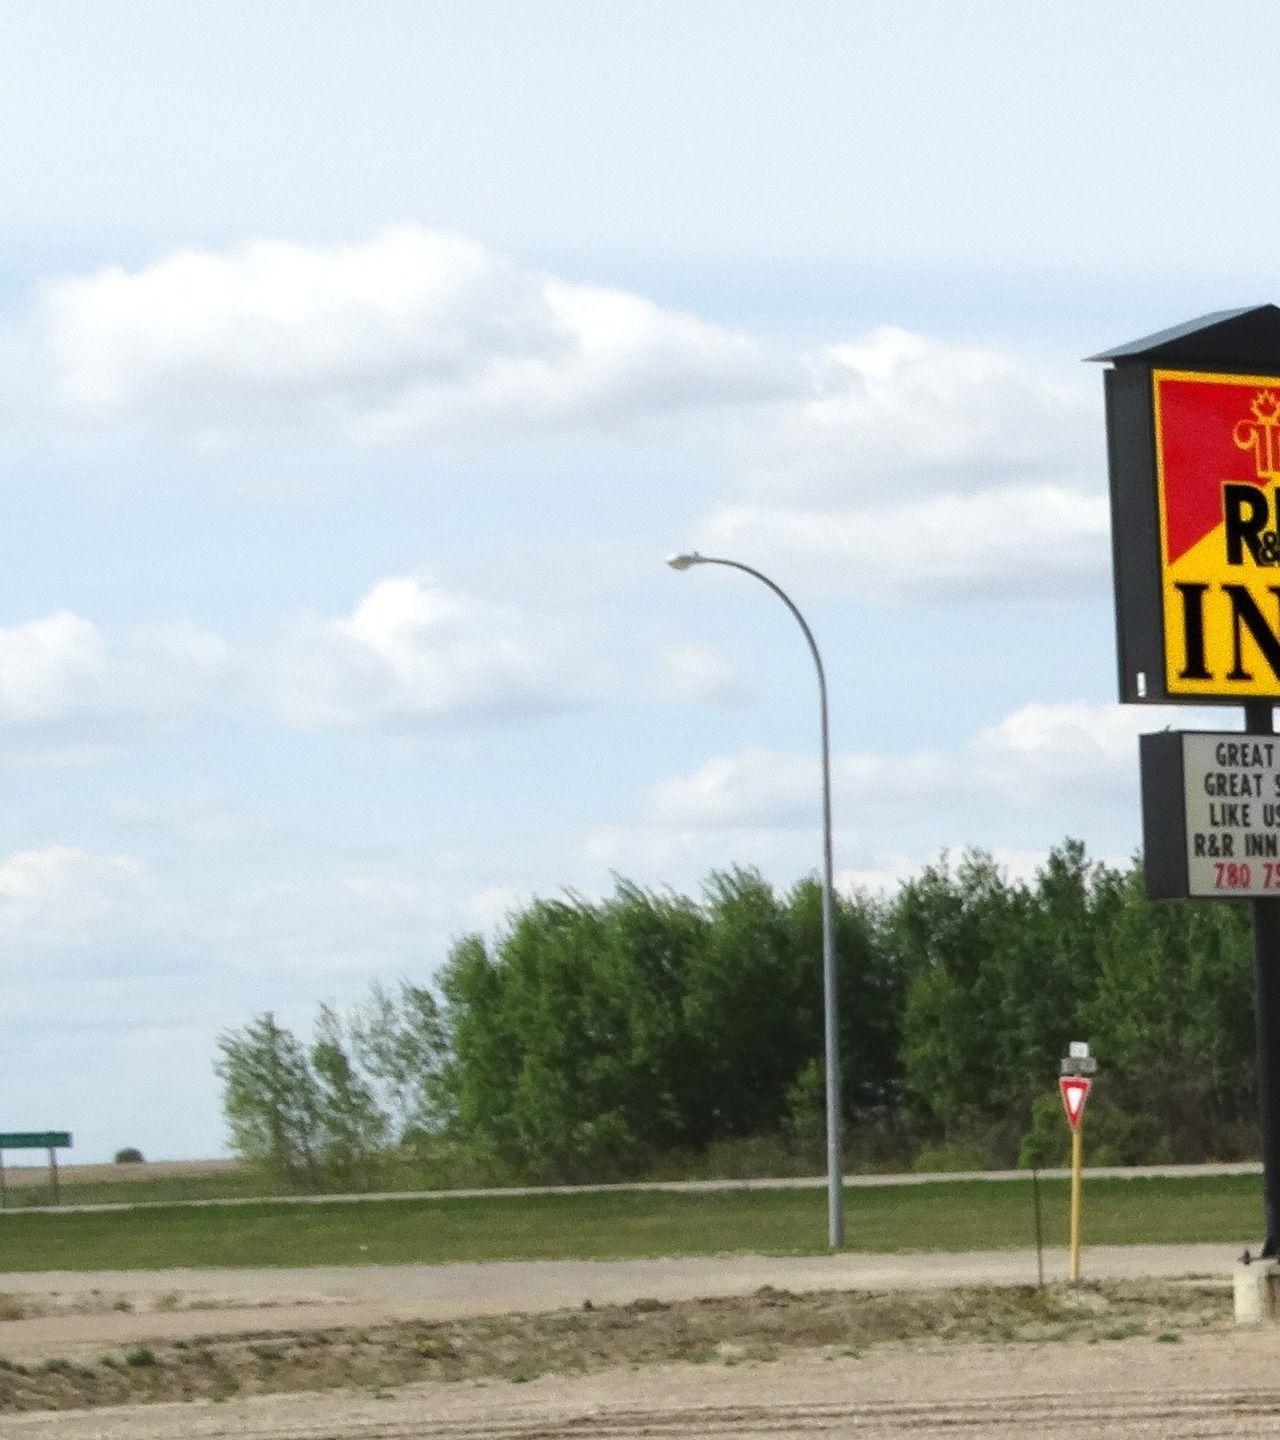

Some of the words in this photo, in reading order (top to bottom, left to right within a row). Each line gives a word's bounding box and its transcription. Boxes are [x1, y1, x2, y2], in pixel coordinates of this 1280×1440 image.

[1216, 743, 1274, 767] GREAT
[1204, 773, 1262, 797] GREAT
[1210, 803, 1251, 828] LIKE
[1194, 833, 1234, 858] R&R
[1245, 834, 1278, 858] INN
[1214, 862, 1251, 889] 780
